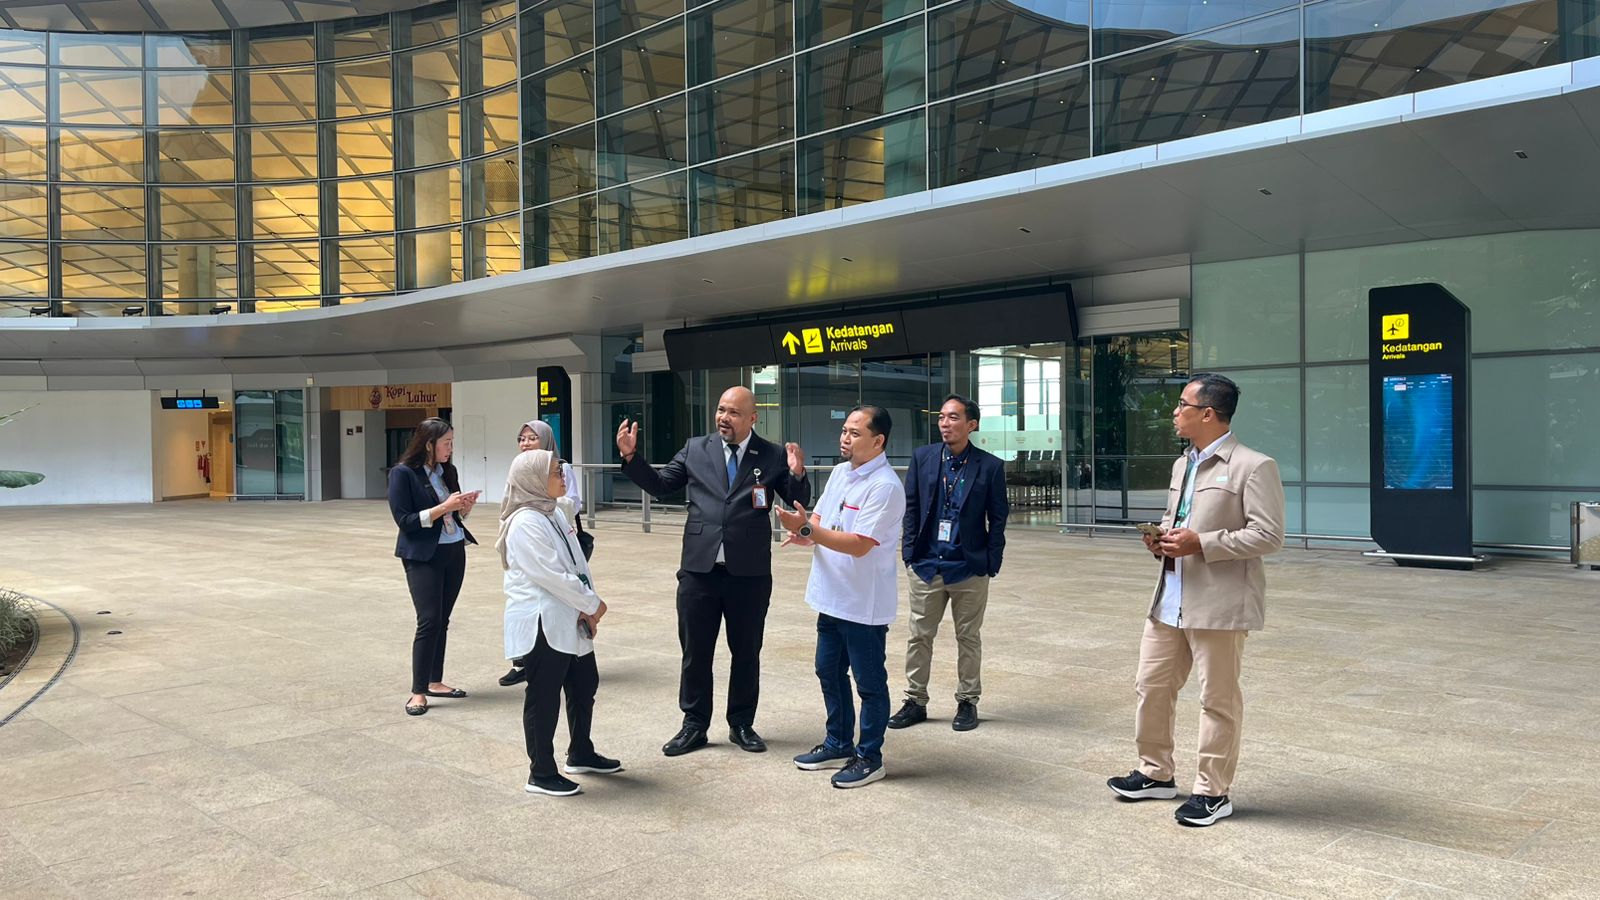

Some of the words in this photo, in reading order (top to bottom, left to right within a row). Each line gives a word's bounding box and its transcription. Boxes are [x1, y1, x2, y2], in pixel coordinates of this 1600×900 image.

[826, 323, 894, 339] Kedatangan
[830, 338, 868, 352] Arrivals
[1382, 342, 1442, 353] Kedatangan
[384, 385, 406, 399] Kopi
[406, 390, 437, 403] Luhur
